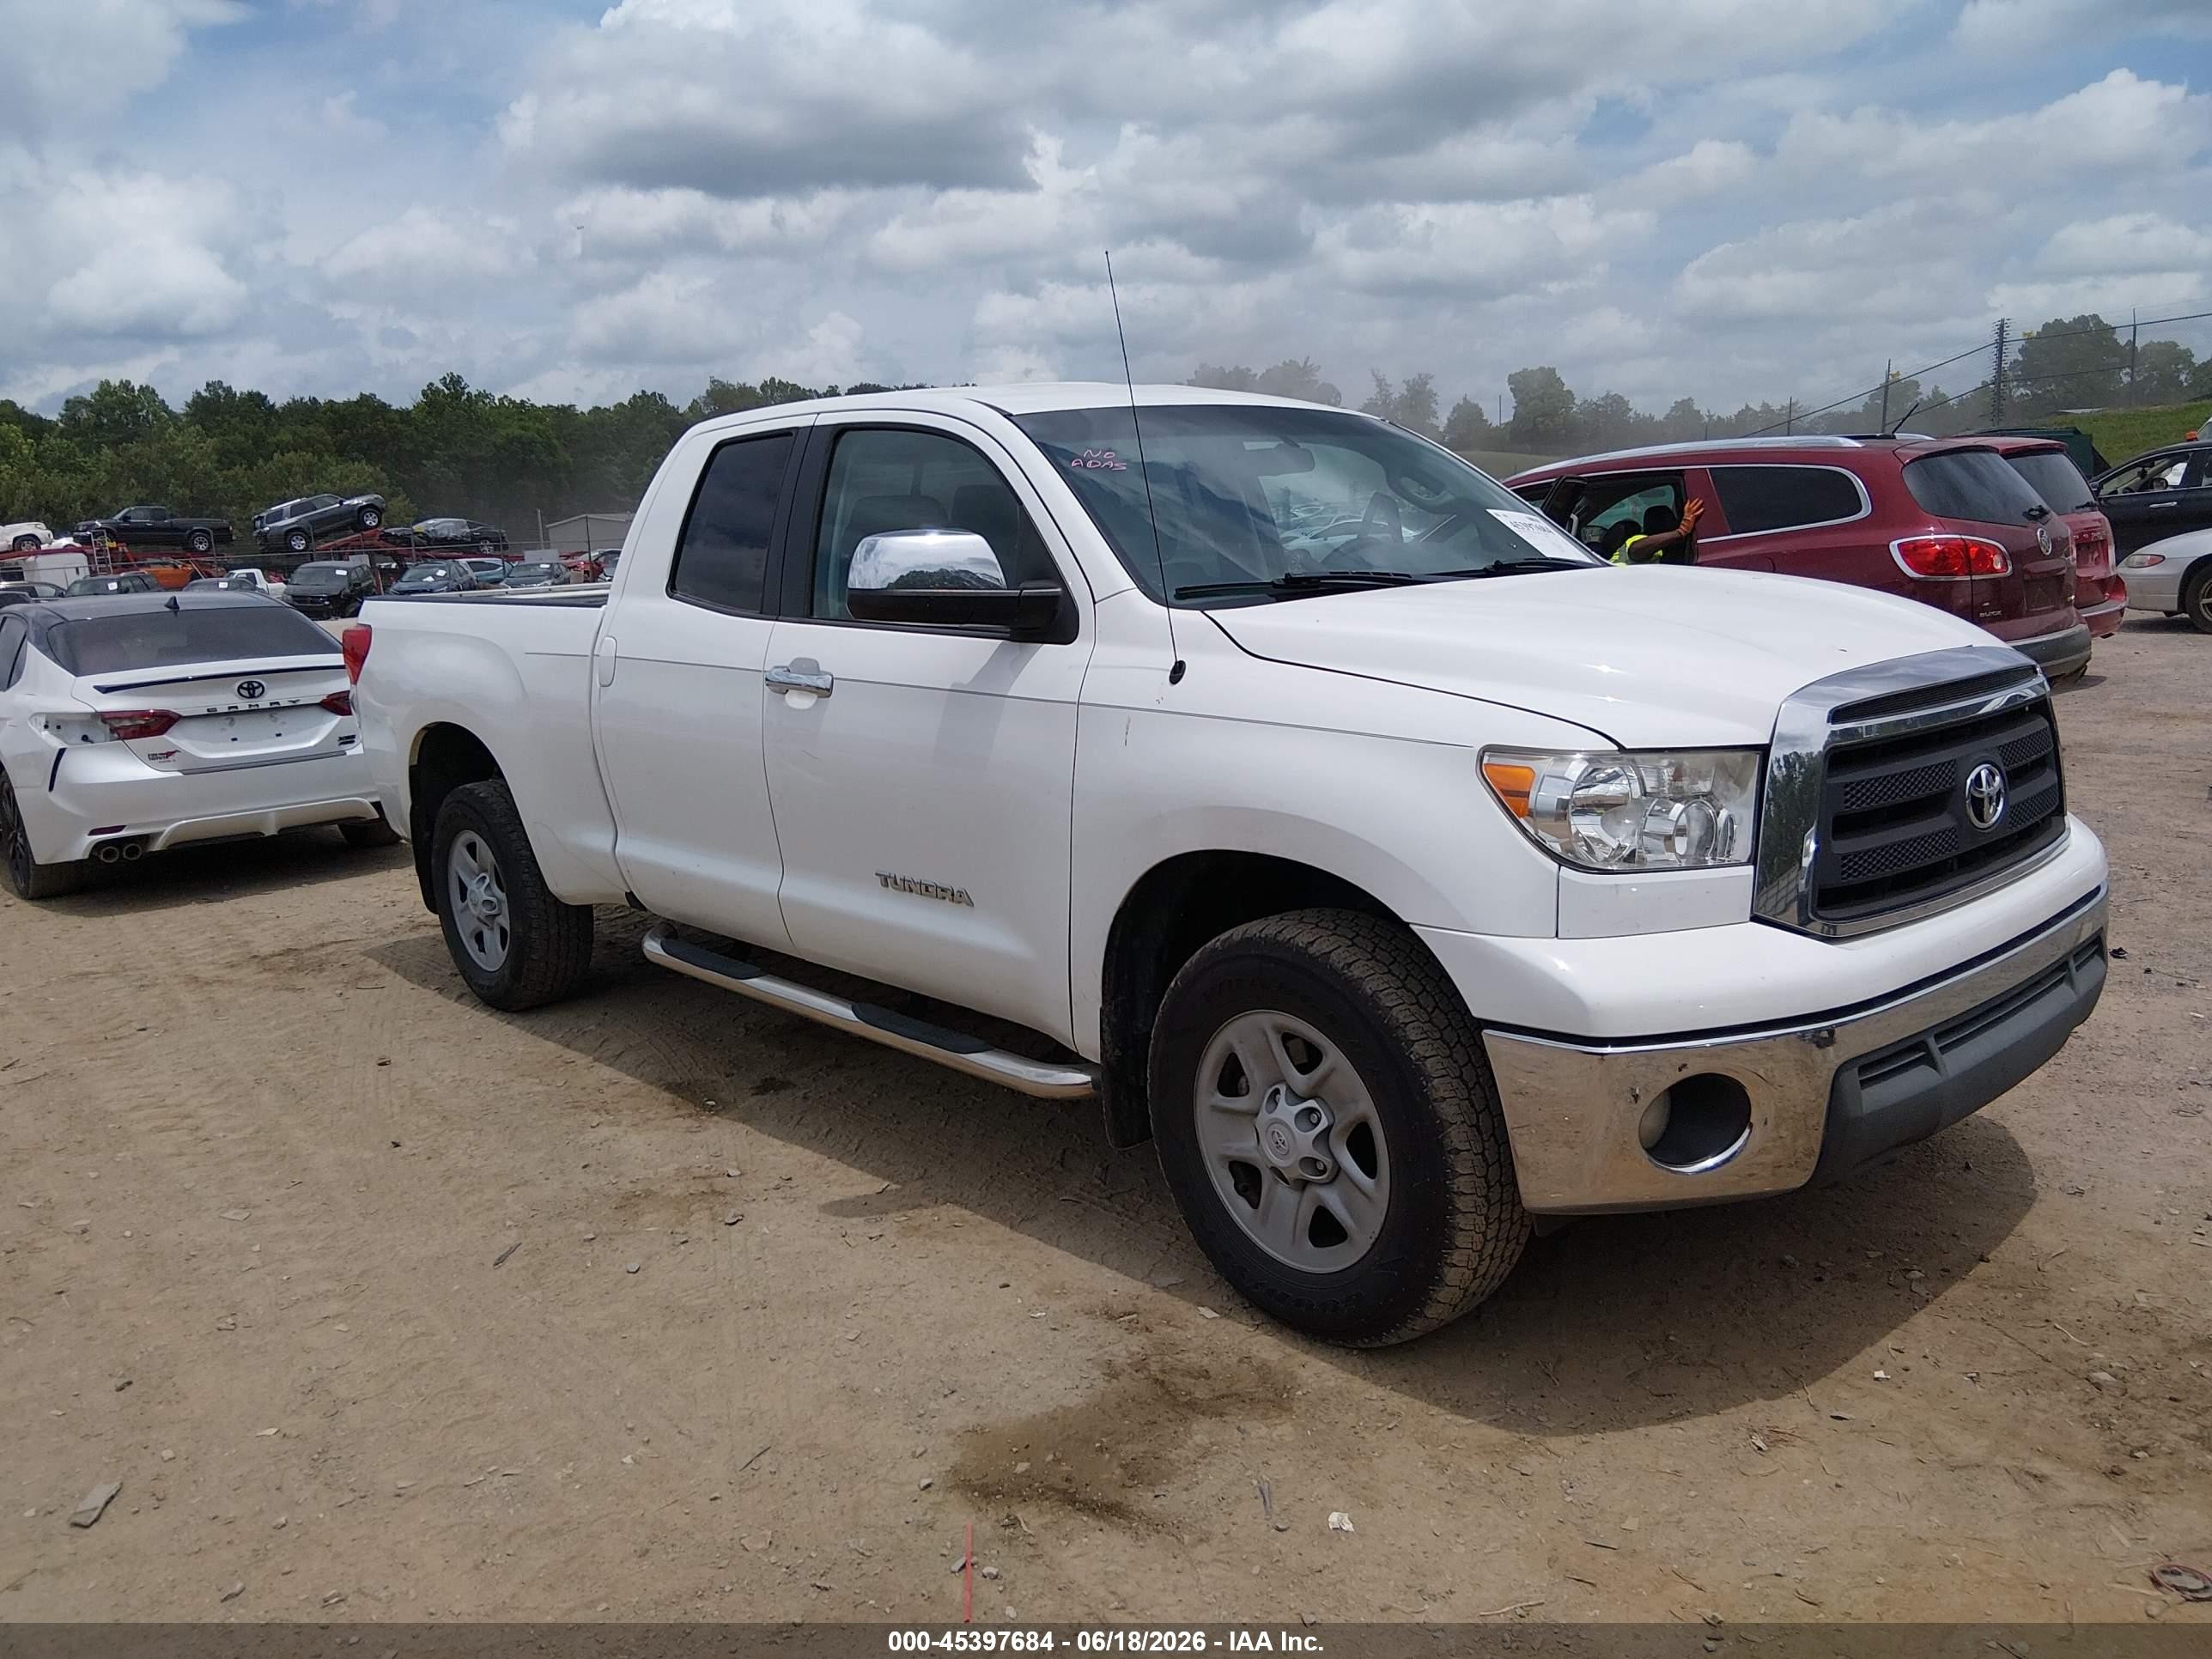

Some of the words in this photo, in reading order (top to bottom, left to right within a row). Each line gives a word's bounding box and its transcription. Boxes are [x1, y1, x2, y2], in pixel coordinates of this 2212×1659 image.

[1084, 448, 1115, 459] NO
[1071, 459, 1127, 471] ADAS
[206, 698, 301, 713] CAMRY
[875, 870, 975, 908] TUNDRA
